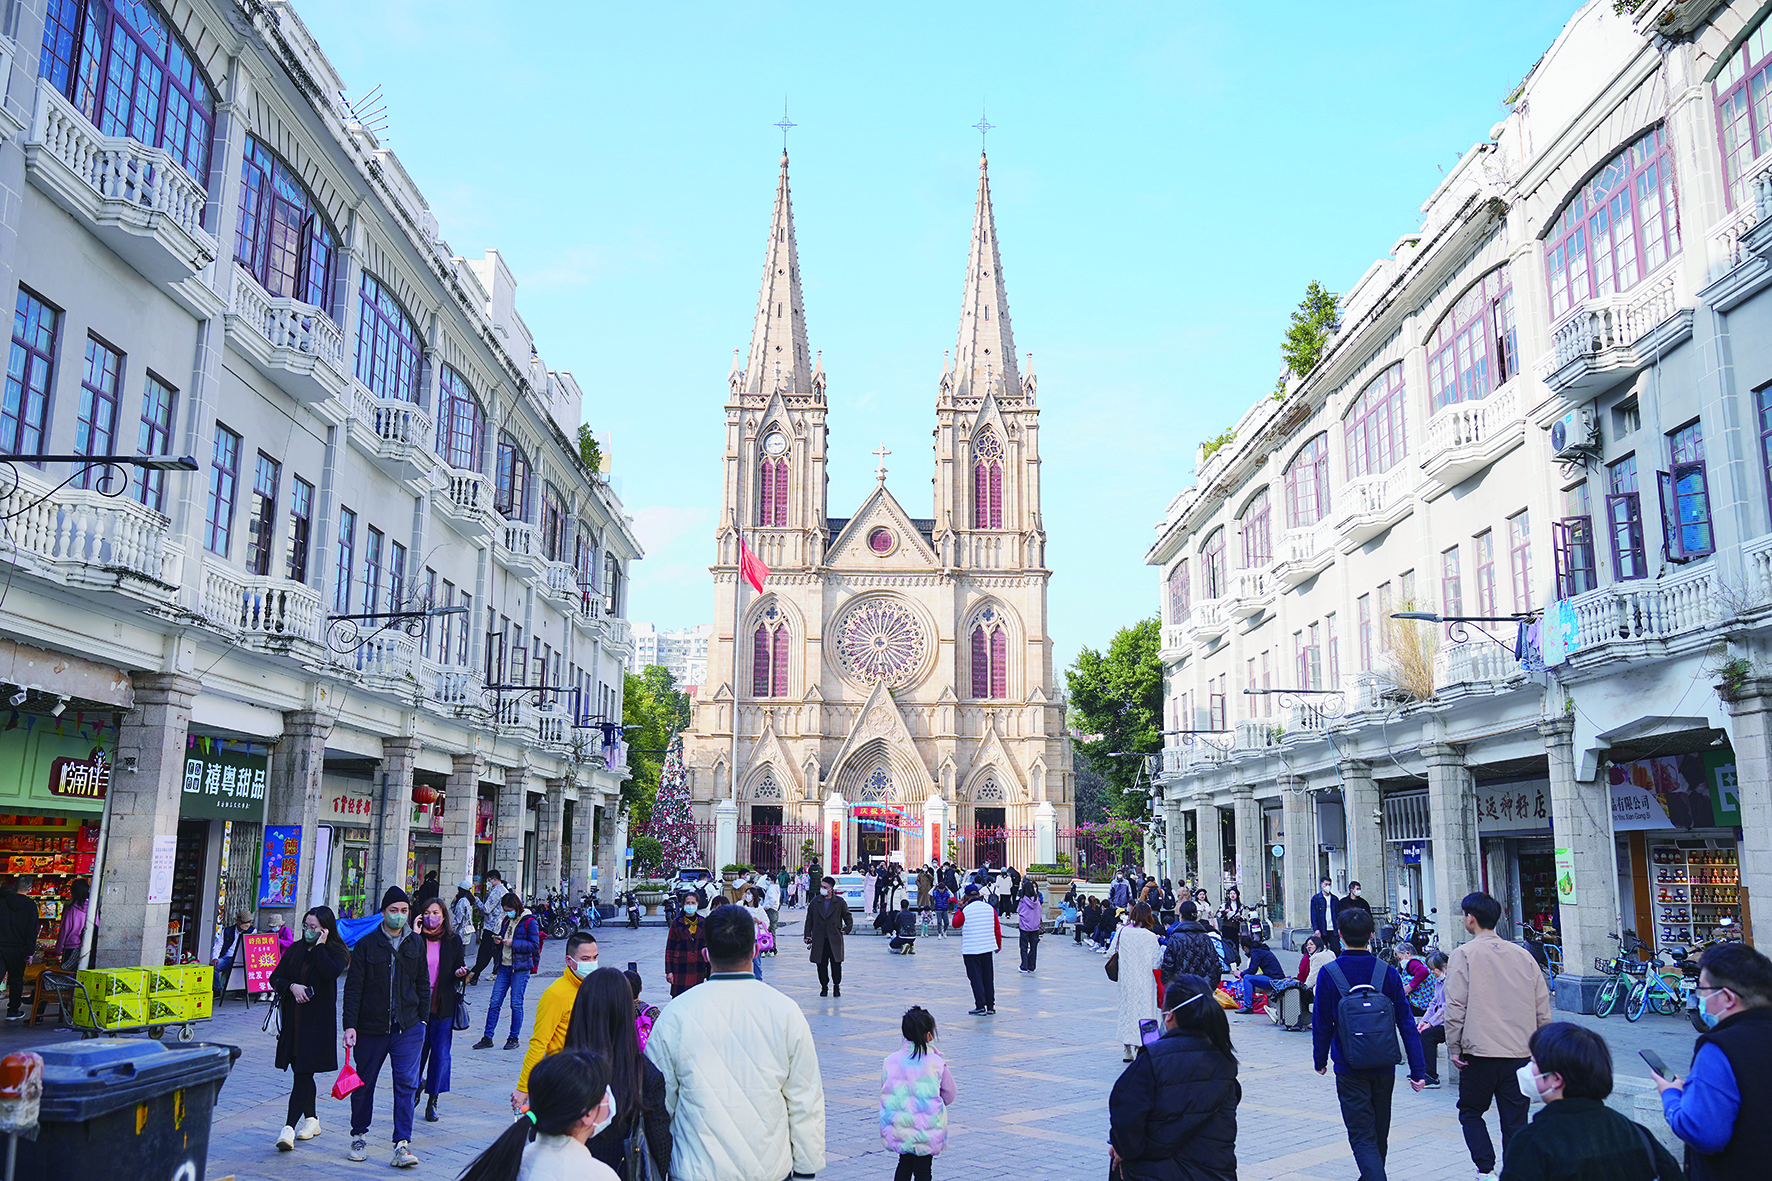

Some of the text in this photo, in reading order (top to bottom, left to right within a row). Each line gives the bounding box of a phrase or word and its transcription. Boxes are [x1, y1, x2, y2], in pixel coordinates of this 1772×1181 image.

[205, 762, 265, 800] 禧粤甜品
[280, 837, 299, 895] 德隆行
